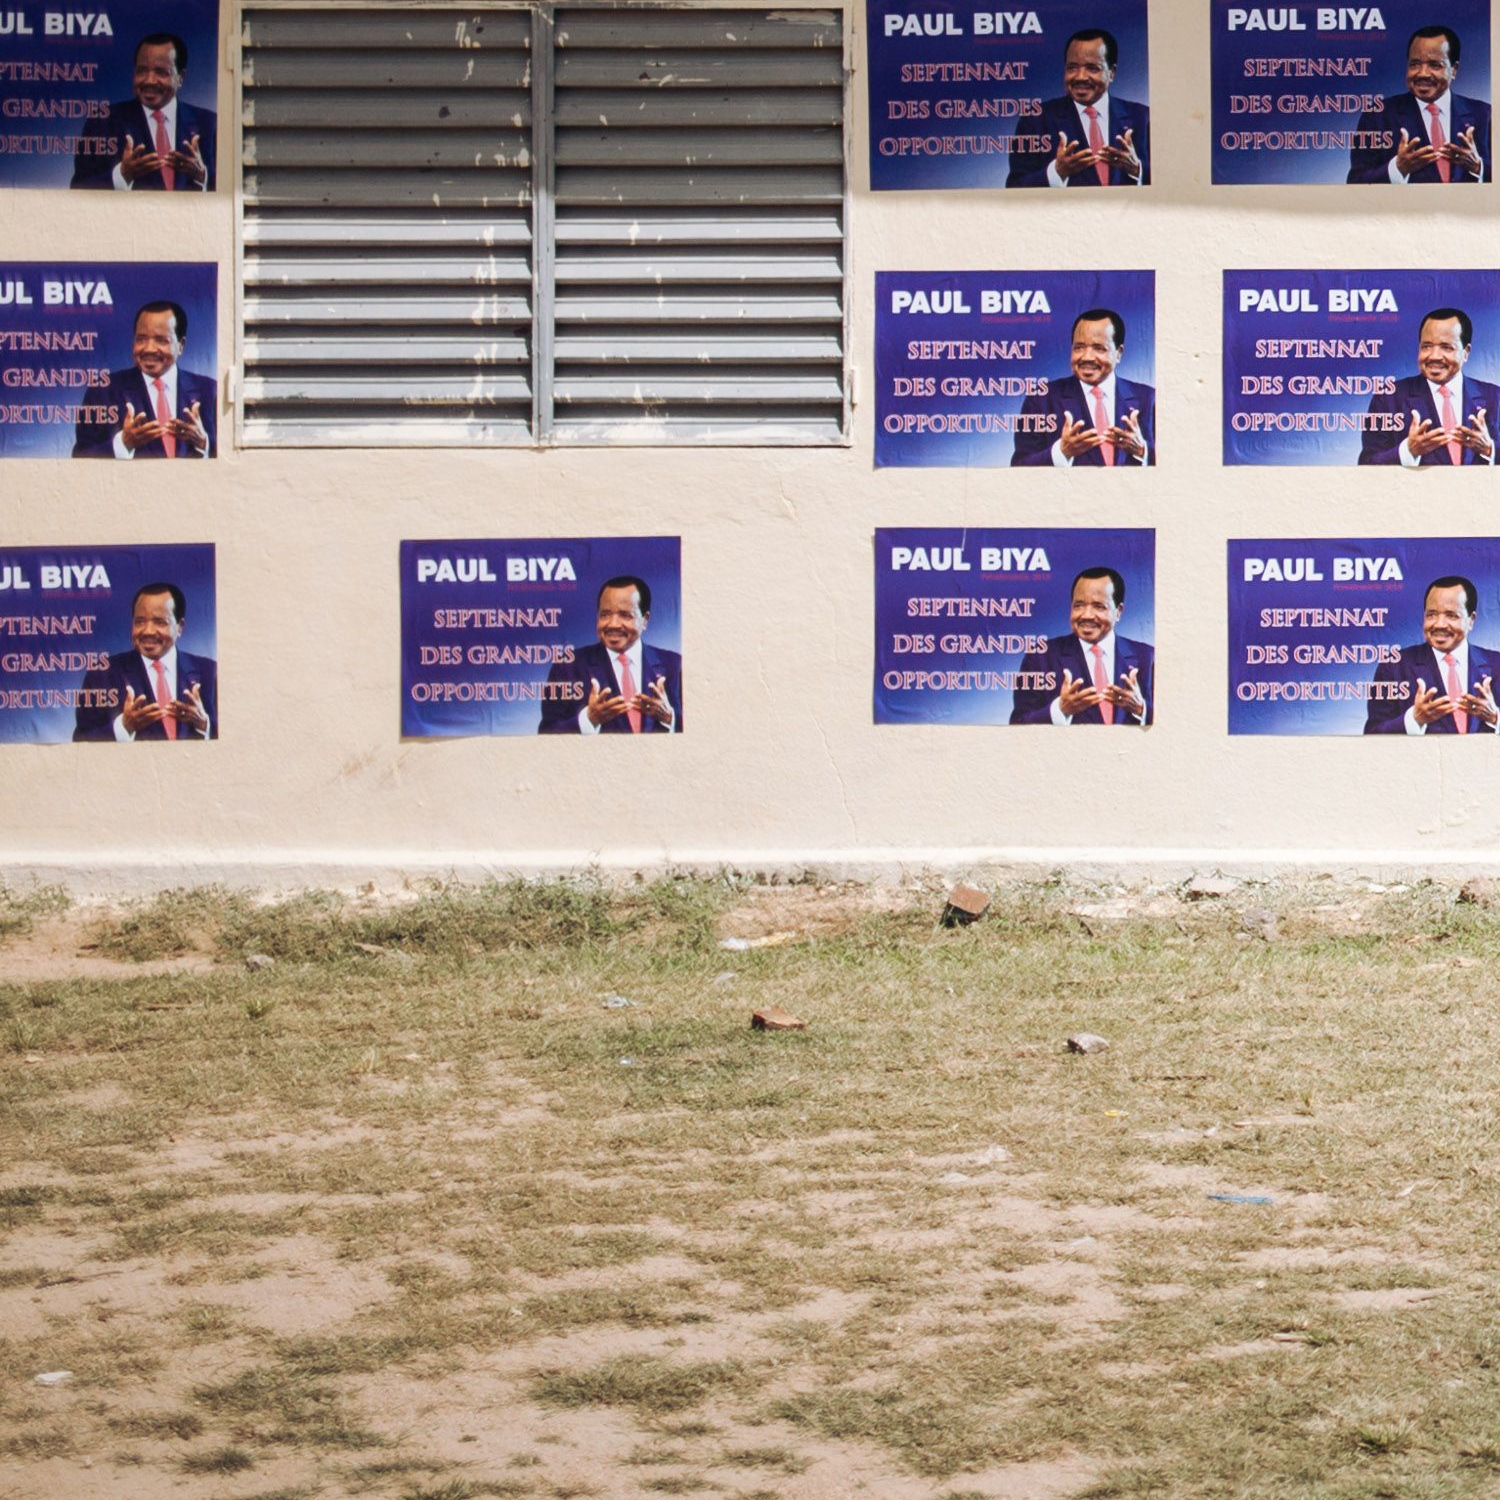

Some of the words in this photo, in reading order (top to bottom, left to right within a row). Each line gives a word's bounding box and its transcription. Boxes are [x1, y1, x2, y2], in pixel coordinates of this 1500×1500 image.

[44, 12, 113, 36] BIYA
[884, 12, 963, 37] PAUL
[973, 11, 1042, 35] BIYA
[1227, 7, 1306, 31] PAUL
[1316, 7, 1385, 31] BIYA
[901, 61, 1028, 82] SEPTENNAT
[1244, 57, 1371, 77] SEPTENNAT
[2, 98, 110, 119] GRANDES
[887, 99, 929, 119] DES
[934, 98, 1042, 118] GRANDES
[1229, 94, 1271, 113] DES
[1277, 94, 1384, 113] GRANDES
[878, 134, 1052, 155] OPPORTUNITES
[1220, 130, 1393, 150] OPPORTUNITES
[43, 281, 112, 305] BIYA
[892, 290, 970, 313] PAUL
[981, 290, 1050, 313] BIYA
[1239, 288, 1318, 312] PAUL
[1329, 289, 1397, 312] BIYA
[908, 340, 1035, 359] SEPTENNAT
[1256, 338, 1382, 358] SEPTENNAT
[2, 368, 110, 387] GRANDES
[893, 377, 935, 396] DES
[940, 377, 1048, 396] GRANDES
[1241, 375, 1282, 394] DES
[1288, 375, 1396, 395] GRANDES
[884, 413, 1057, 432] OPPORTUNITES
[1231, 412, 1404, 431] OPPORTUNITES
[891, 546, 970, 570] PAUL
[981, 547, 1050, 571] BIYA
[41, 564, 110, 589] BIYA
[417, 558, 496, 582] PAUL
[507, 557, 576, 581] BIYA
[1244, 557, 1323, 581] PAUL
[1333, 557, 1402, 581] BIYA
[908, 597, 1034, 617] SEPTENNAT
[1261, 607, 1387, 627] SEPTENNAT
[434, 608, 561, 628] SEPTENNAT
[892, 634, 934, 653] DES
[940, 634, 1048, 654] GRANDES
[1246, 645, 1288, 664] DES
[1293, 644, 1401, 663] GRANDES
[1, 652, 110, 672] GRANDES
[419, 645, 461, 665] DES
[467, 644, 575, 664] GRANDES
[883, 670, 1056, 690] OPPORTUNITES
[410, 681, 584, 701] OPPORTUNITES
[1237, 681, 1410, 700] OPPORTUNITES
